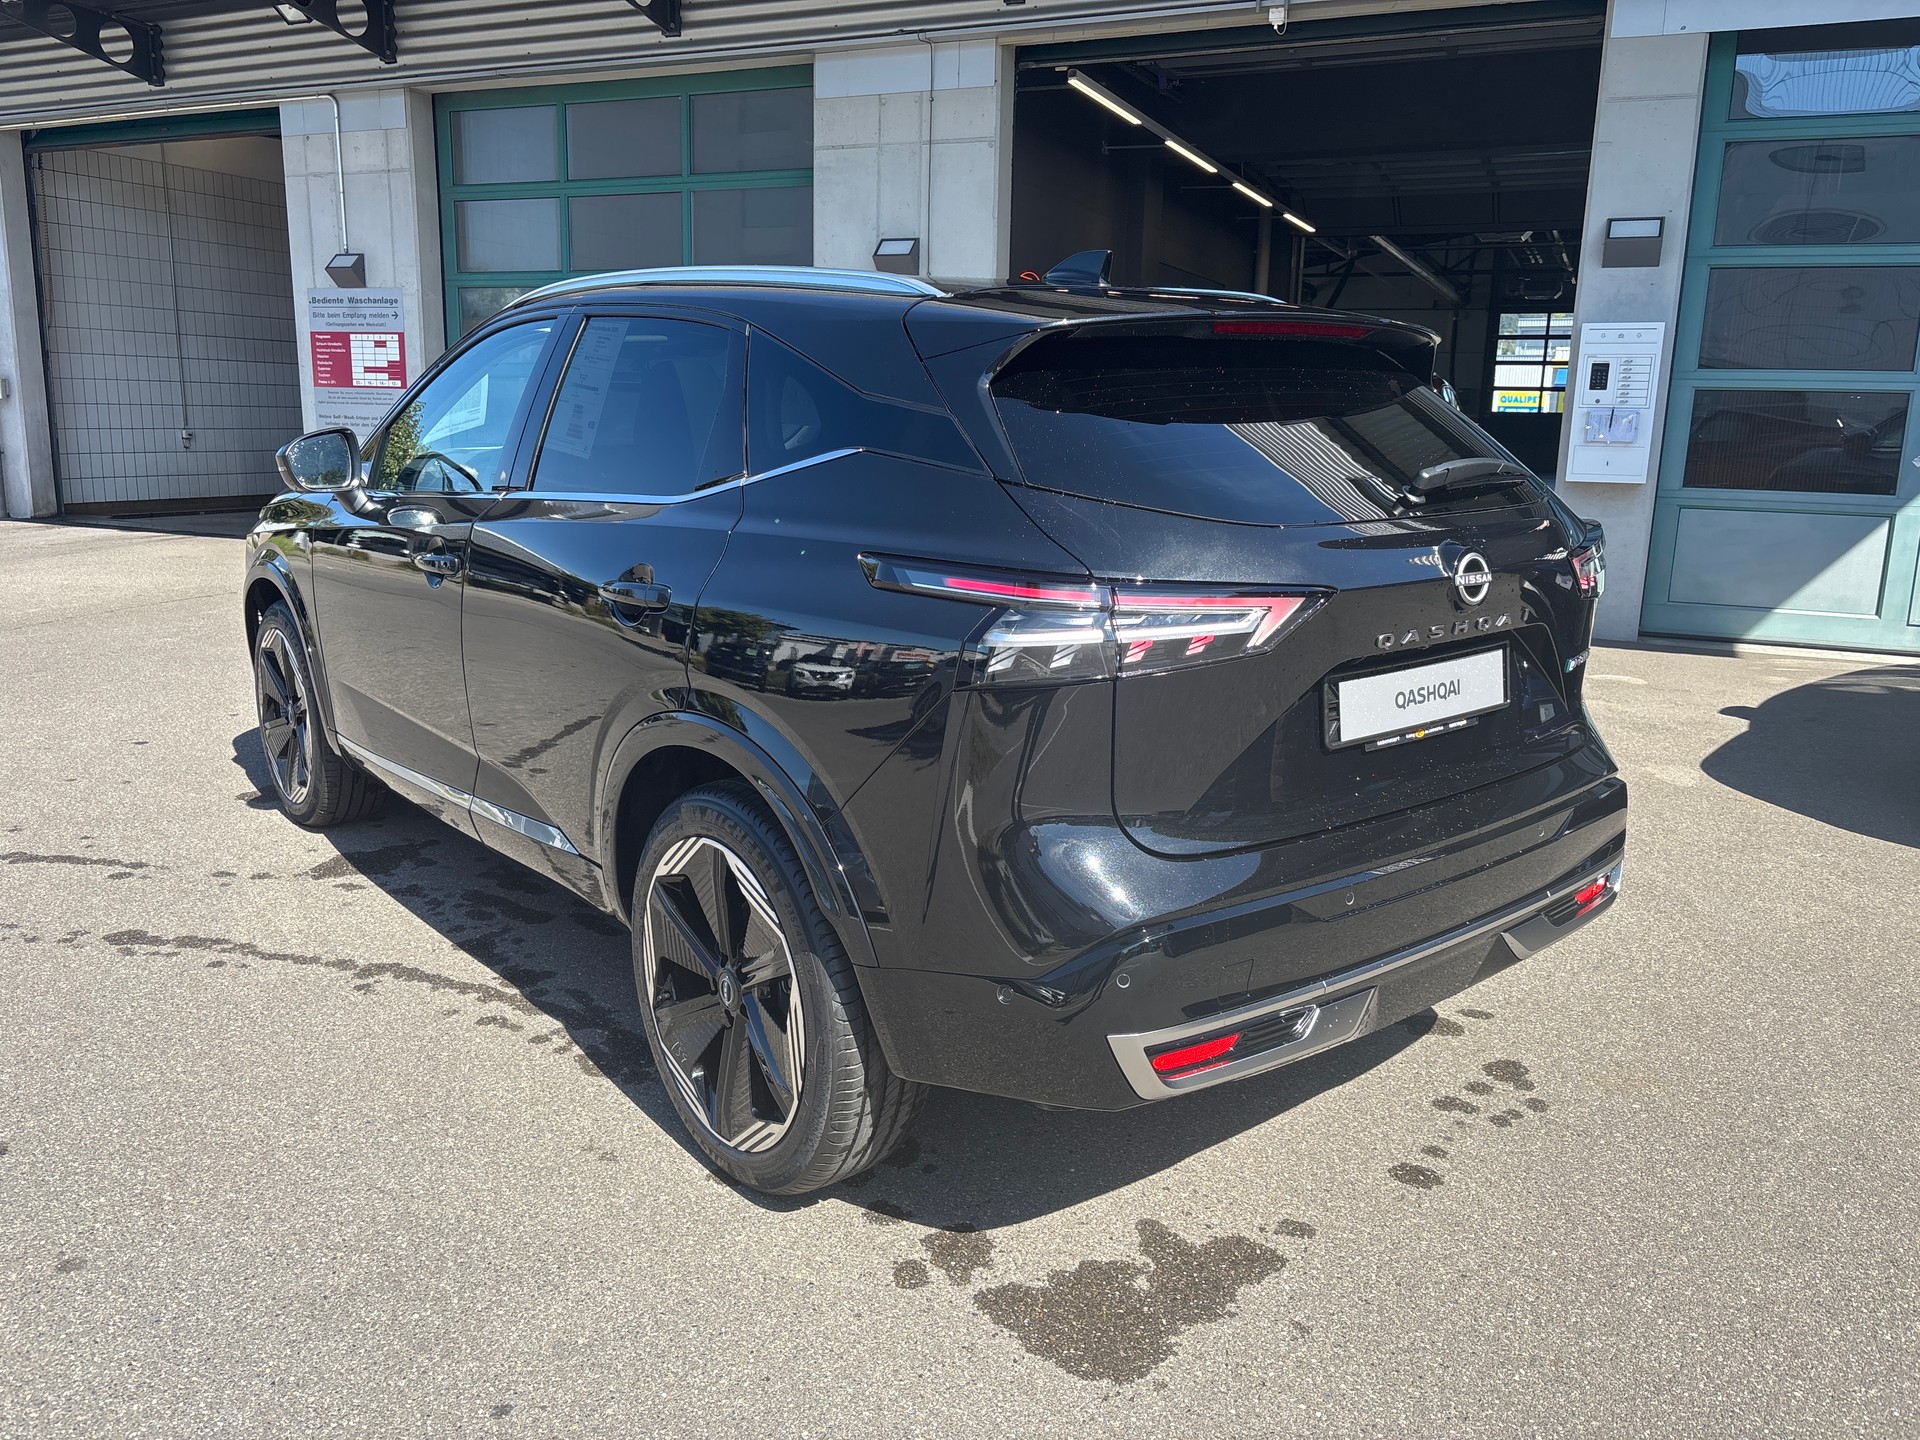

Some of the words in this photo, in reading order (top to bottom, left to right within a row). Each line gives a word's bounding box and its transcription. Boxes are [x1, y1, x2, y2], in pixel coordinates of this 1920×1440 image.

[311, 296, 344, 304] Bediente
[347, 296, 399, 306] Waschanlage
[342, 312, 367, 321] Empfang
[1500, 395, 1540, 404] QUALIPE
[1456, 572, 1492, 585] NISSAN
[1374, 606, 1530, 650] QASHQAI
[1394, 678, 1461, 710] QASHQAI
[701, 807, 780, 888] MICHELIN
